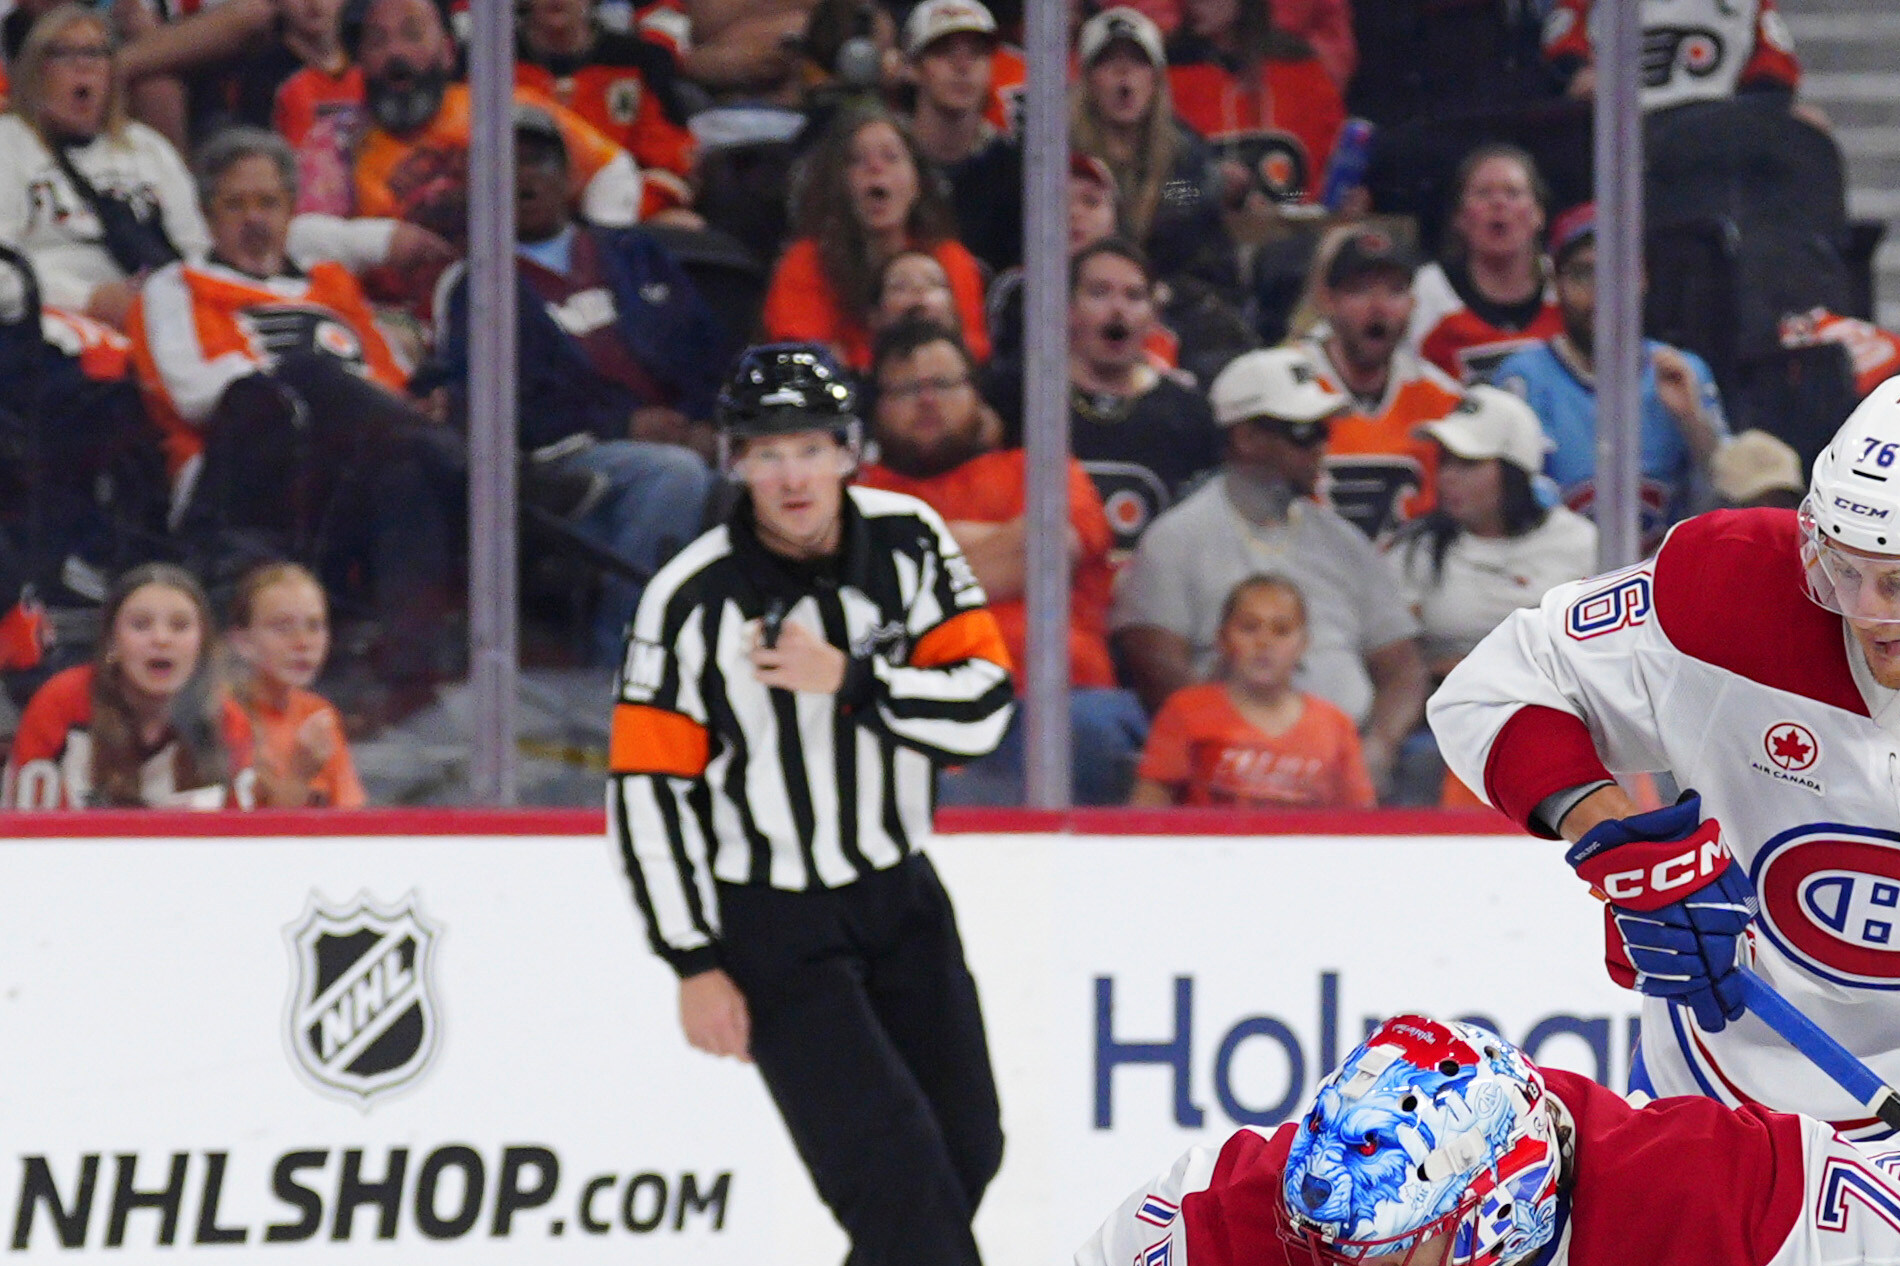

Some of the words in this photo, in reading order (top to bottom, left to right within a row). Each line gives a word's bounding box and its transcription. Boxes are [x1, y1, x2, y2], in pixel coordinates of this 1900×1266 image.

[1857, 437, 1900, 467] 76
[1834, 497, 1889, 519] CCM
[1752, 762, 1771, 776] AIR
[1773, 770, 1821, 791] CANADA
[1604, 832, 1731, 899] CCM
[318, 940, 416, 1060] NHL
[11, 1144, 733, 1252] NHLSHOP.COM
